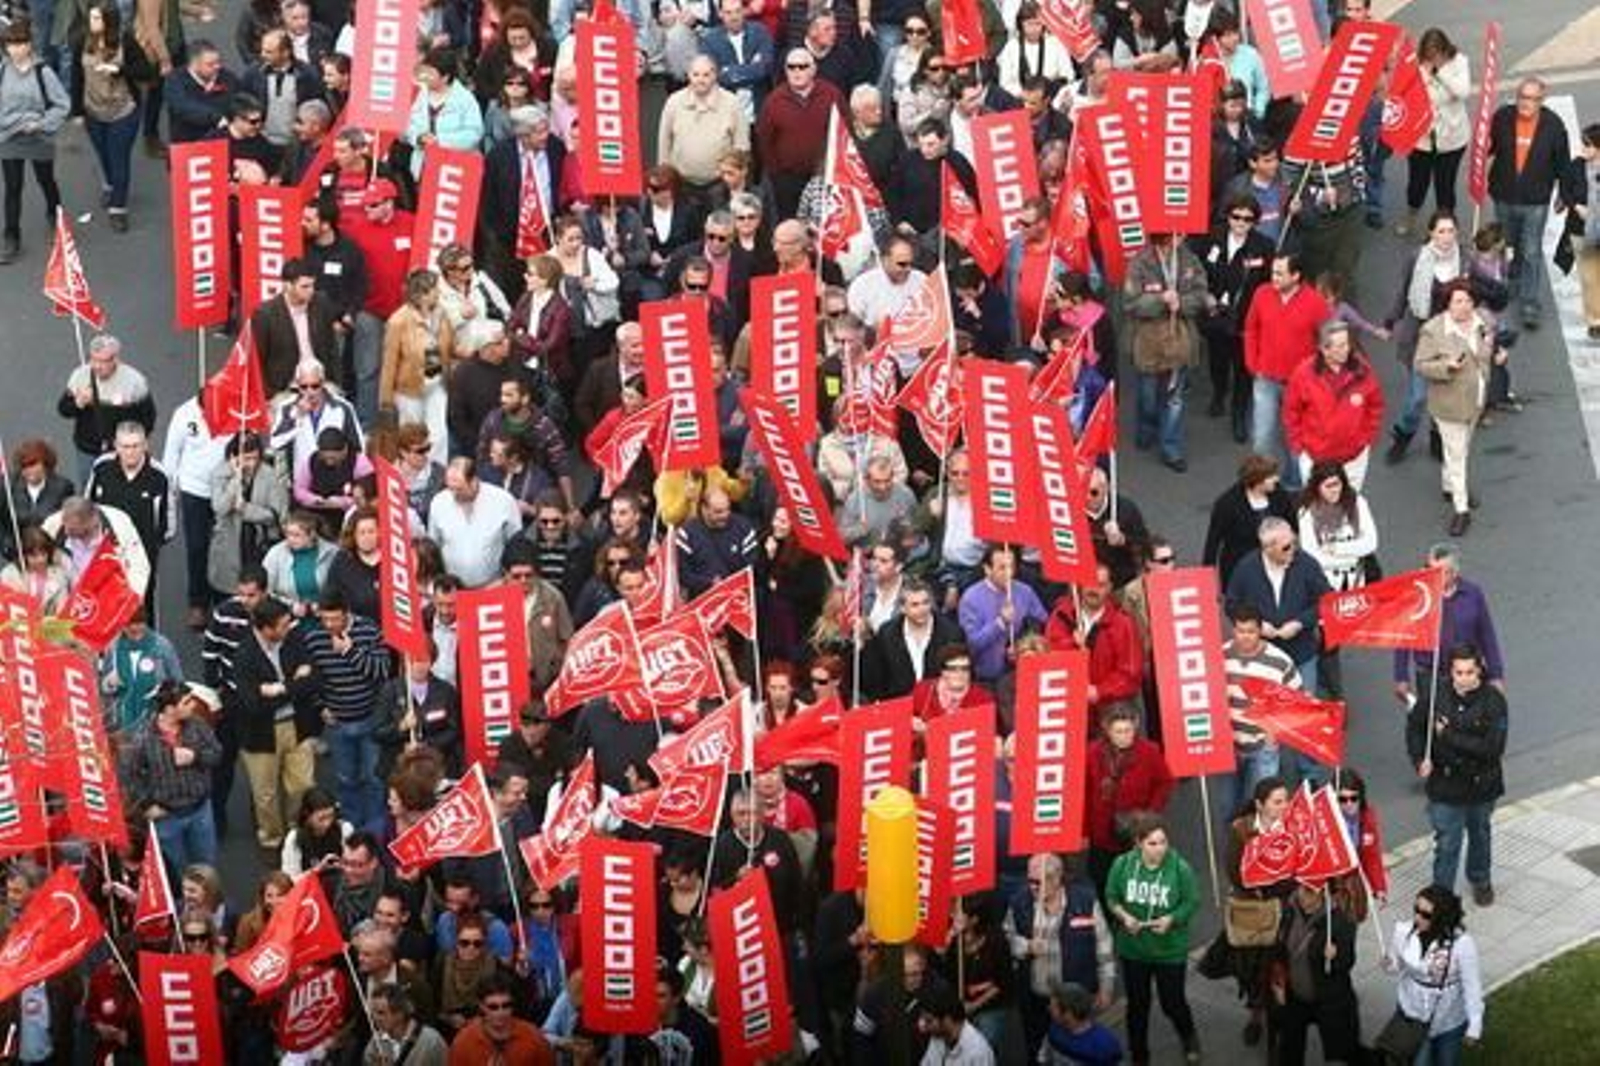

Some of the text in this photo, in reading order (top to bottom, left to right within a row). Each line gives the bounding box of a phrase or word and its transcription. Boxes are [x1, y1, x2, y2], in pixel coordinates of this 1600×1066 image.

[373, 0, 399, 72] COO
[593, 36, 621, 137] CCOO
[1320, 33, 1377, 117] CCOO
[989, 125, 1026, 239] CCOO
[1097, 115, 1139, 223] CCOO
[1165, 88, 1190, 181] CCOO
[189, 157, 214, 268] CCOO
[258, 199, 285, 301] CCOO
[661, 313, 697, 413] CCOO
[773, 289, 799, 394] CCOO
[757, 408, 808, 508] CCOO
[982, 376, 1013, 484] CCOO
[1033, 416, 1072, 525] CCOO
[388, 476, 410, 603] CCOO
[478, 605, 510, 716] CCOO
[568, 634, 614, 676] UGT
[643, 639, 692, 674] UGT
[1170, 588, 1209, 709] CCOO
[66, 668, 103, 784] CCOO
[1037, 671, 1067, 790] CCOO
[424, 795, 471, 840] UGT
[604, 856, 633, 968] CCOO
[733, 898, 767, 1010] CCOO
[161, 972, 197, 1060] CCO
[290, 970, 335, 1015] UGT
